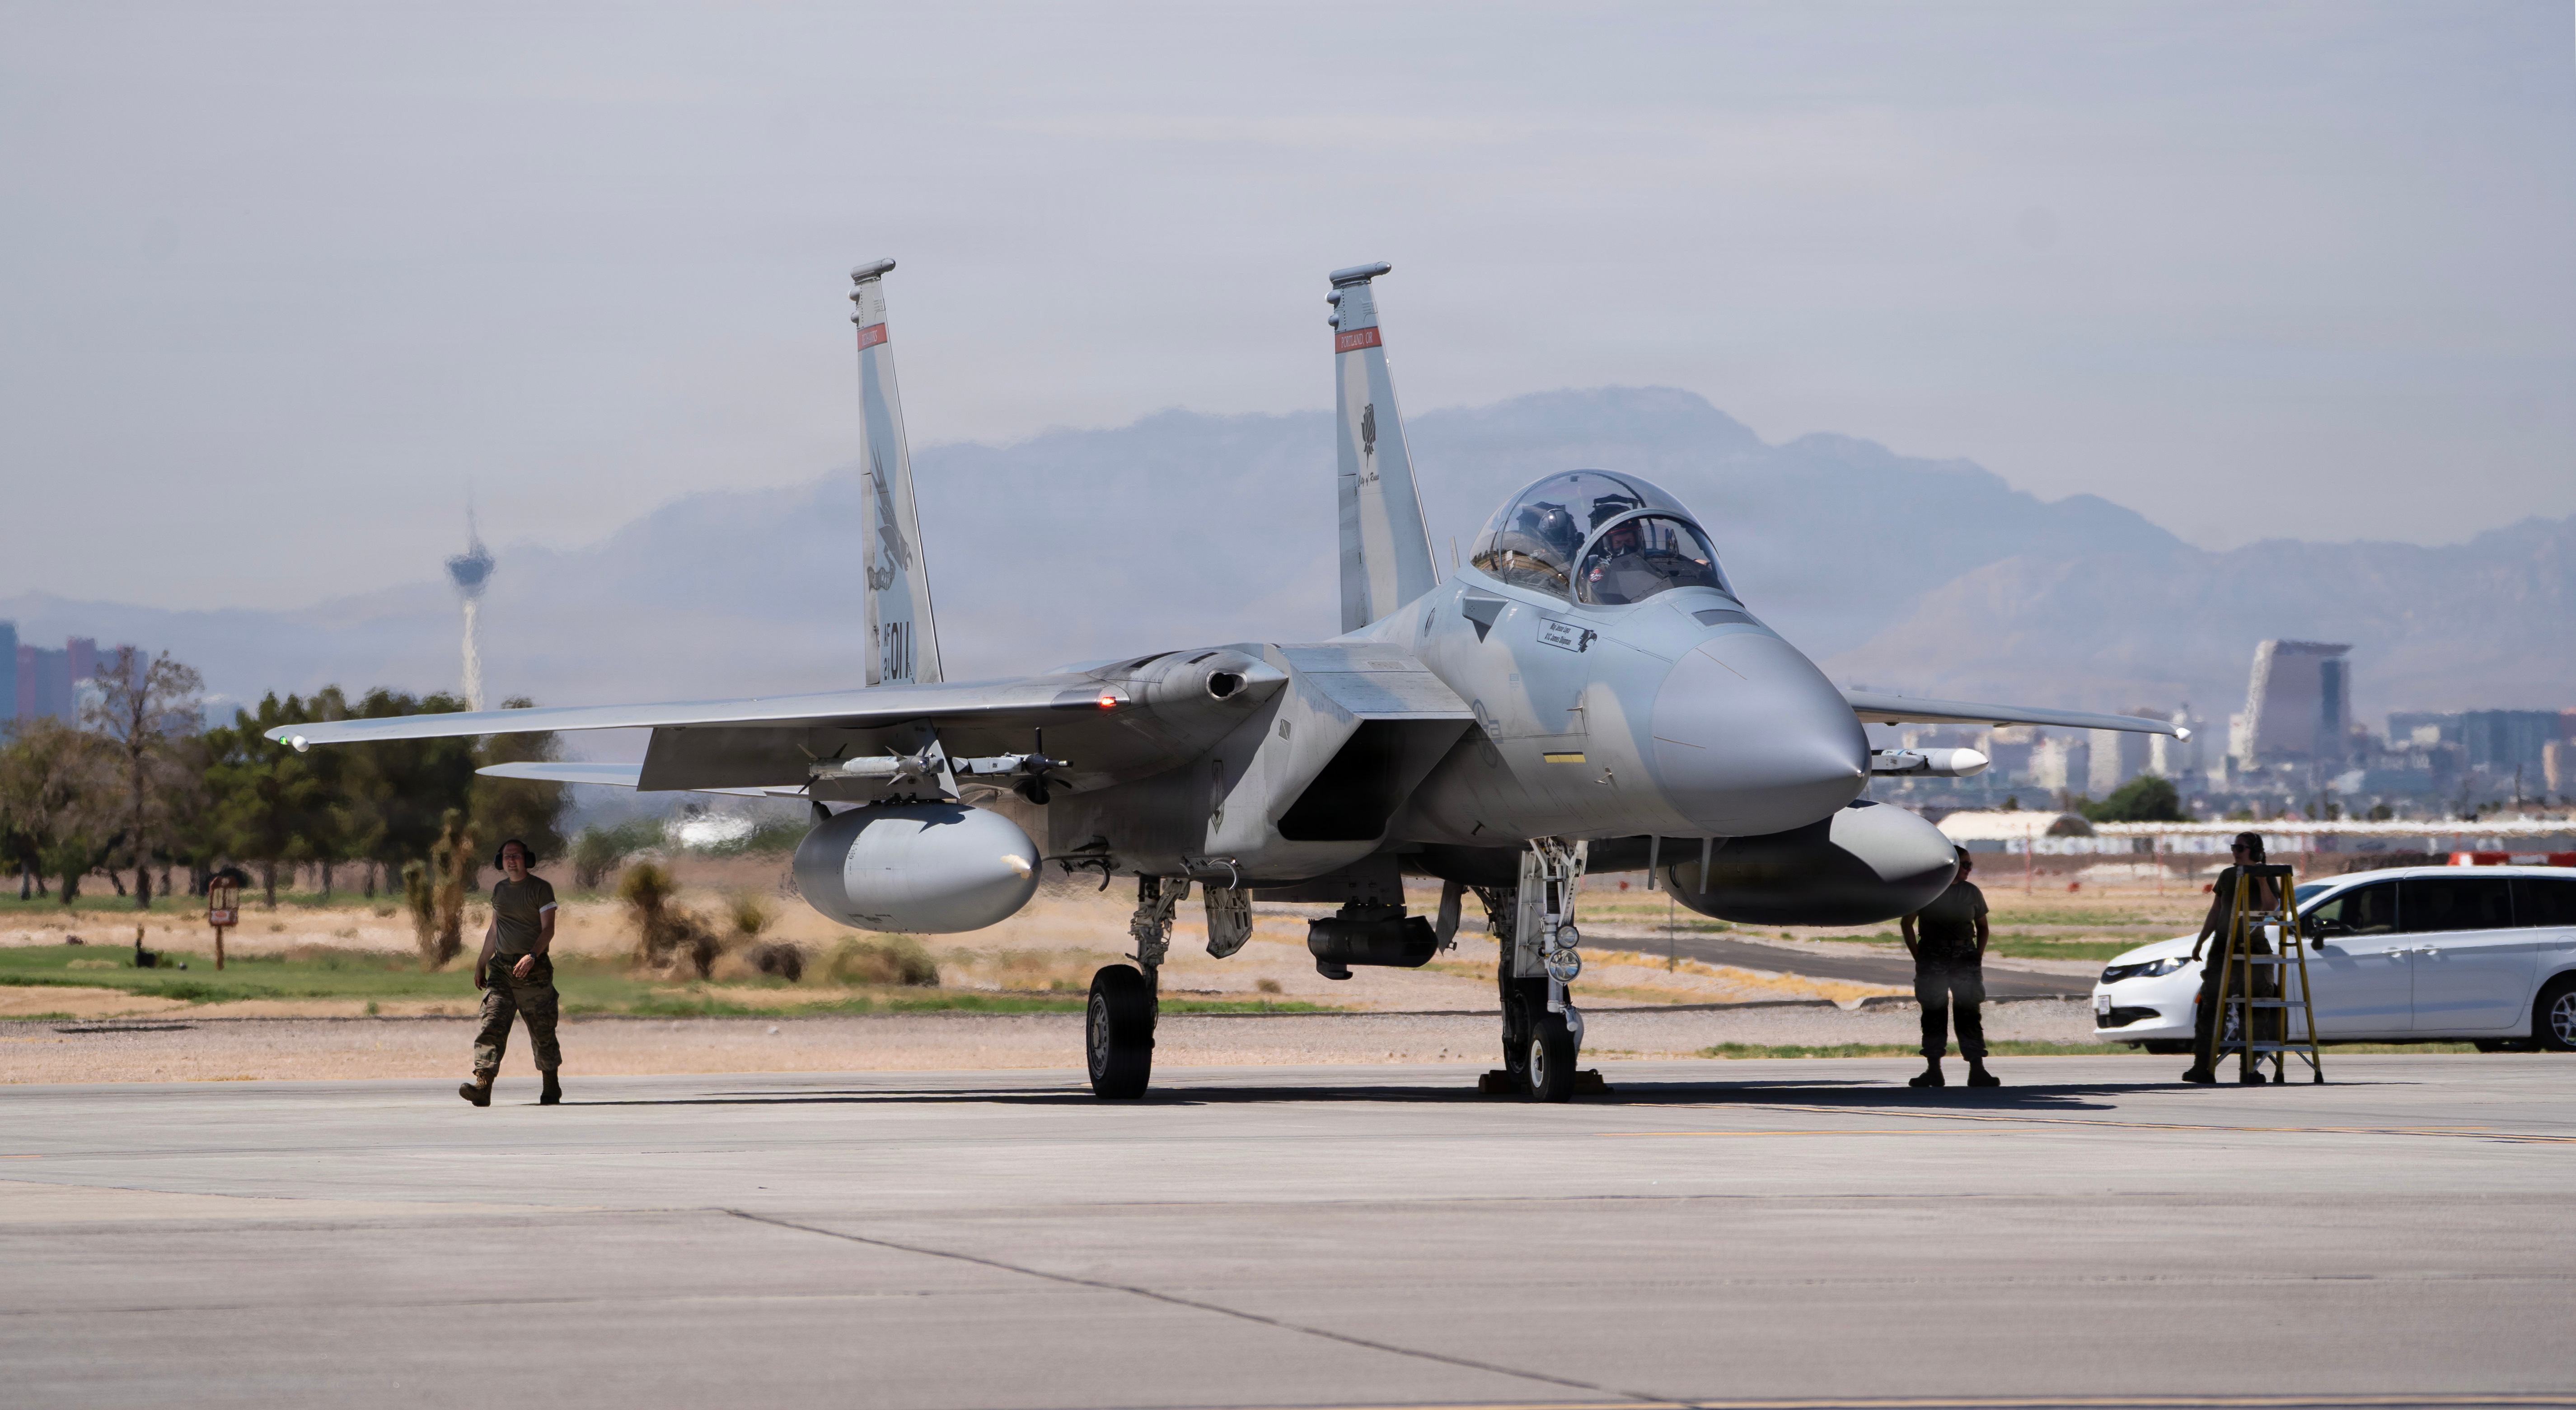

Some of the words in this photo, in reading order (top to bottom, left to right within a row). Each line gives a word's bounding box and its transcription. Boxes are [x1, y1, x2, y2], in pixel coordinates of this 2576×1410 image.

[1341, 334, 1364, 348] PORTLAND,
[1365, 332, 1373, 343] OR
[1366, 474, 1369, 486] of
[1370, 472, 1379, 483] Roses
[884, 623, 890, 647] AF
[1550, 623, 1558, 632] Maj
[1555, 624, 1564, 632] Jesse
[1550, 634, 1560, 643] James
[891, 621, 909, 680] 011
[884, 658, 890, 681] 21
